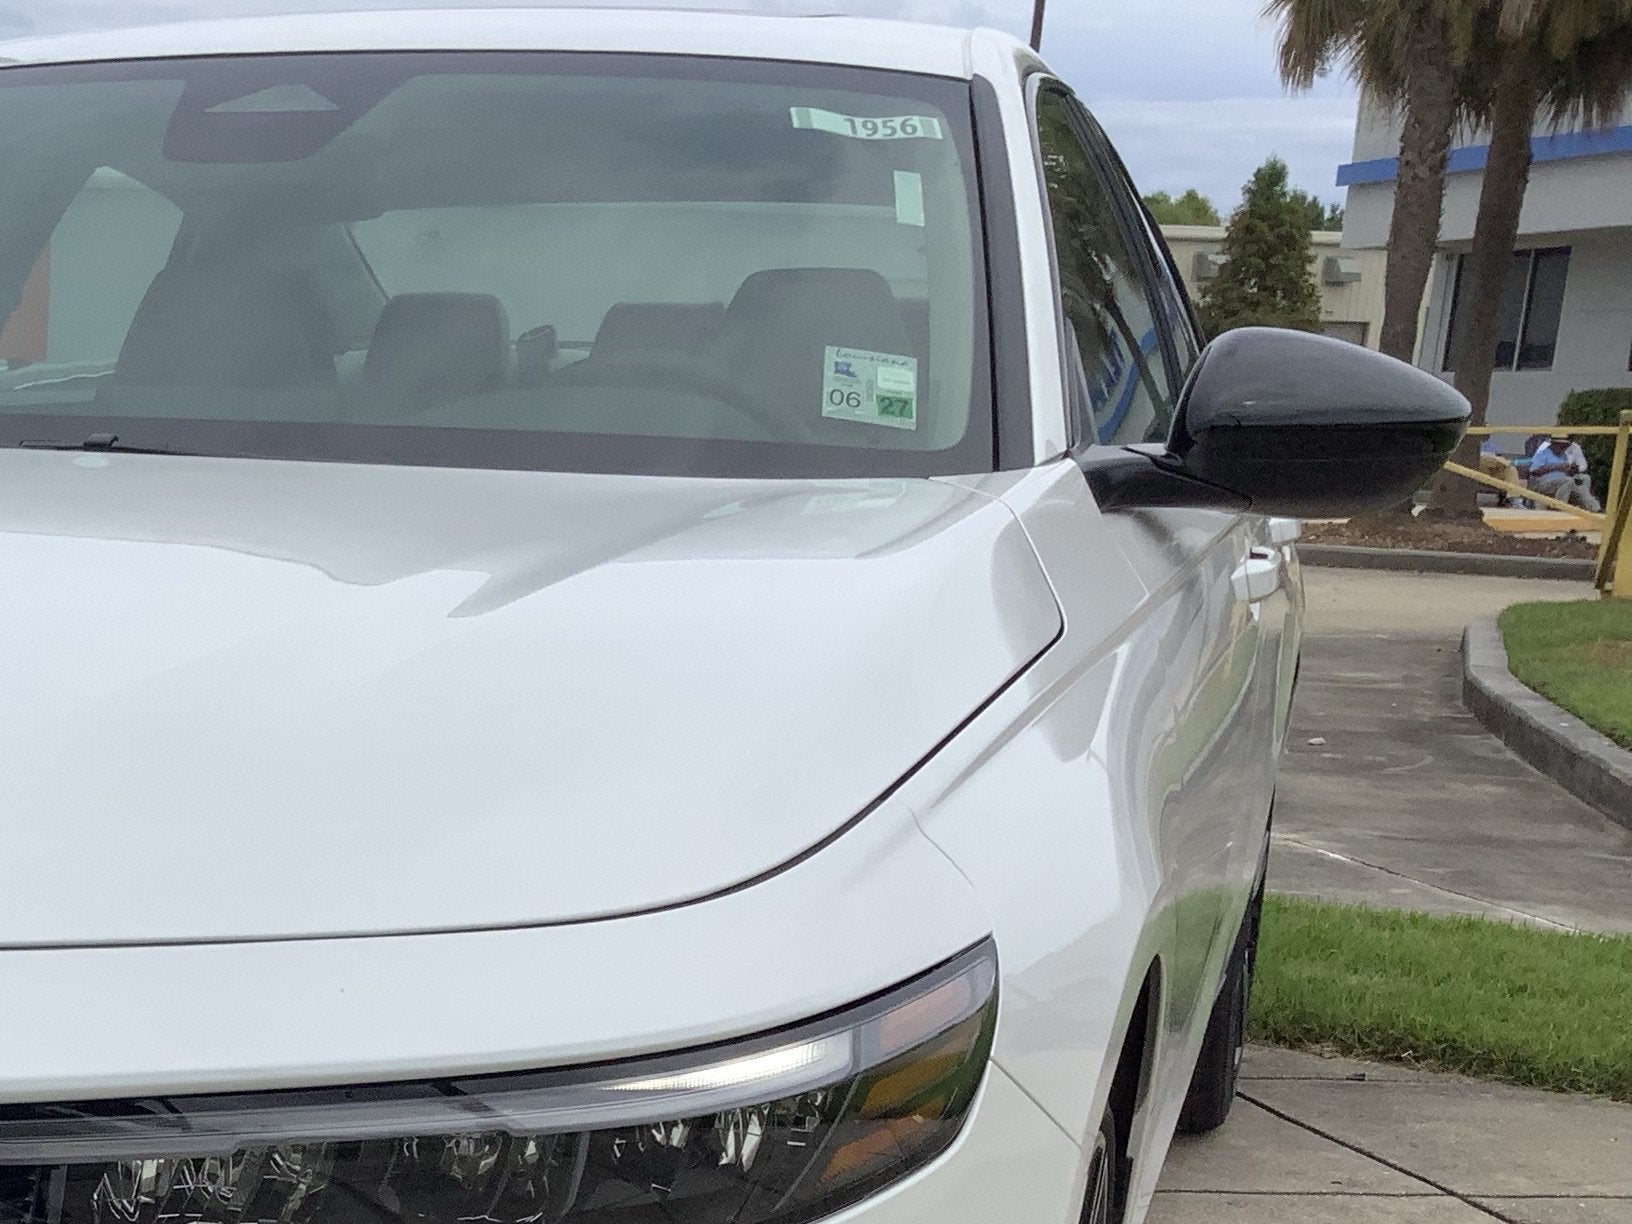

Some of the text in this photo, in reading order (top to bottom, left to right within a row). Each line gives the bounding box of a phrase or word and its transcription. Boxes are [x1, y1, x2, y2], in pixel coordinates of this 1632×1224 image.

[844, 117, 918, 138] 1956
[829, 388, 861, 408] 06
[879, 396, 909, 416] 27
